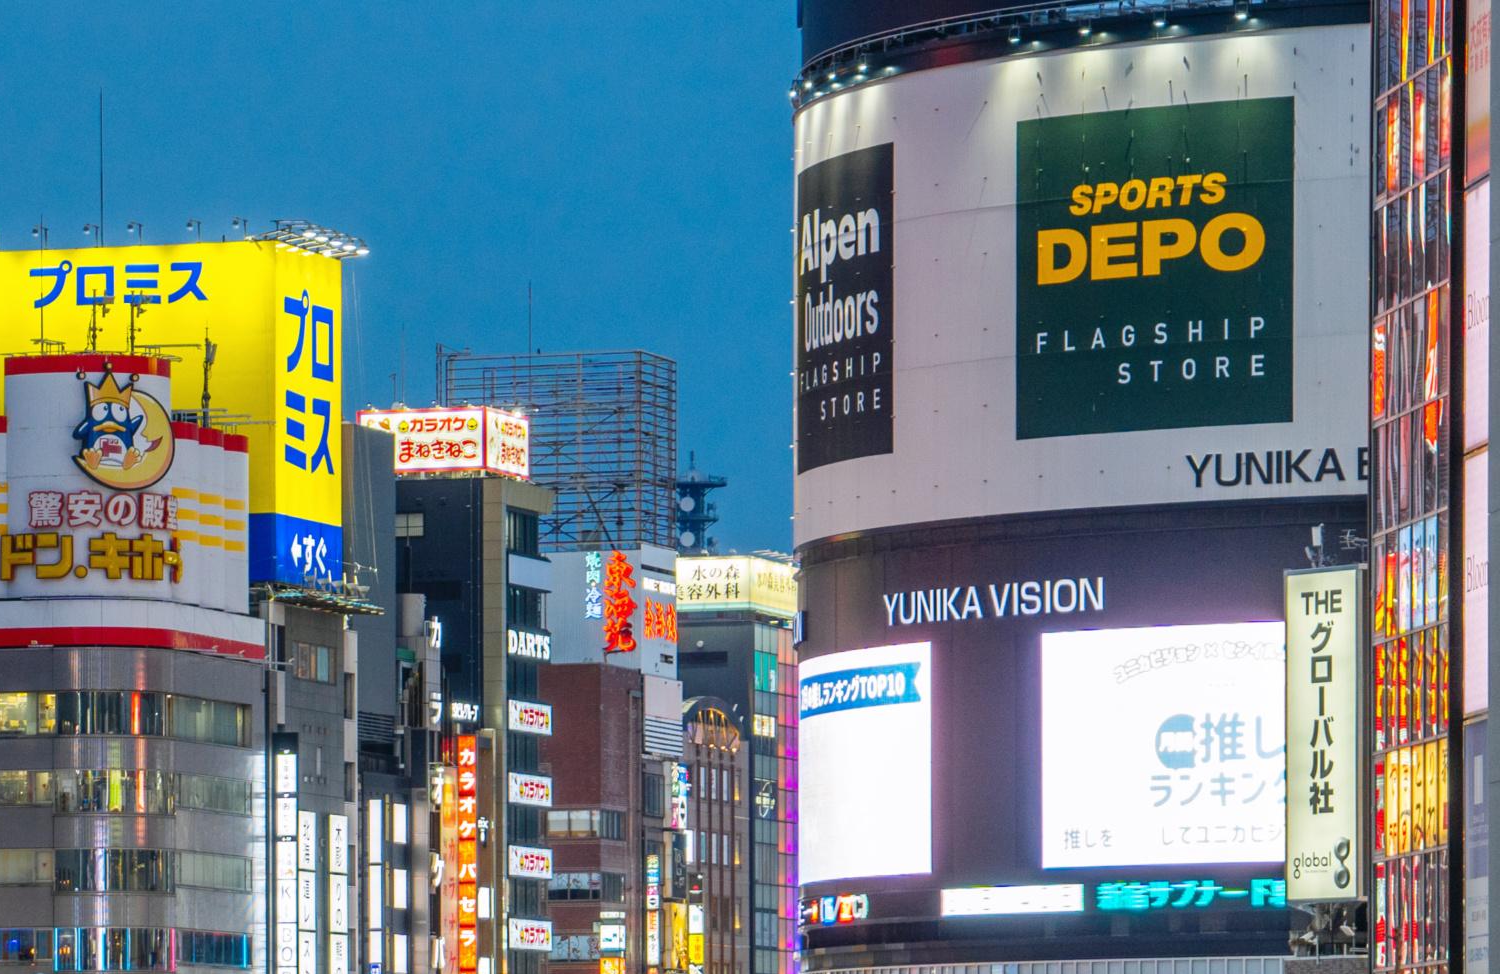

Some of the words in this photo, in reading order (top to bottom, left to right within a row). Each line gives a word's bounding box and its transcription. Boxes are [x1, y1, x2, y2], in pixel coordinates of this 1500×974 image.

[1068, 172, 1227, 217] SPORTS
[799, 207, 880, 284] Alpen
[1036, 211, 1266, 286] DEPO
[29, 260, 208, 309] プロミス
[803, 286, 879, 353] Outdoors
[1035, 316, 1265, 354] FLAGSHIP
[799, 352, 882, 393] FLAGSHIP
[1117, 354, 1265, 385] STORE
[410, 417, 467, 433] カラオケ
[820, 389, 882, 421] STORE
[398, 437, 477, 463] まねきねこ
[1185, 446, 1346, 488] YUNIKA
[303, 533, 328, 571] すぐ
[883, 586, 984, 628] YUNIKA
[989, 576, 1105, 618] VISION
[1301, 588, 1343, 617] THE
[508, 629, 550, 659] DARTS
[1310, 620, 1335, 816] グローバル社
[459, 748, 476, 838] カラオケ
[1293, 851, 1332, 880] global
[458, 864, 476, 947] パセラ
